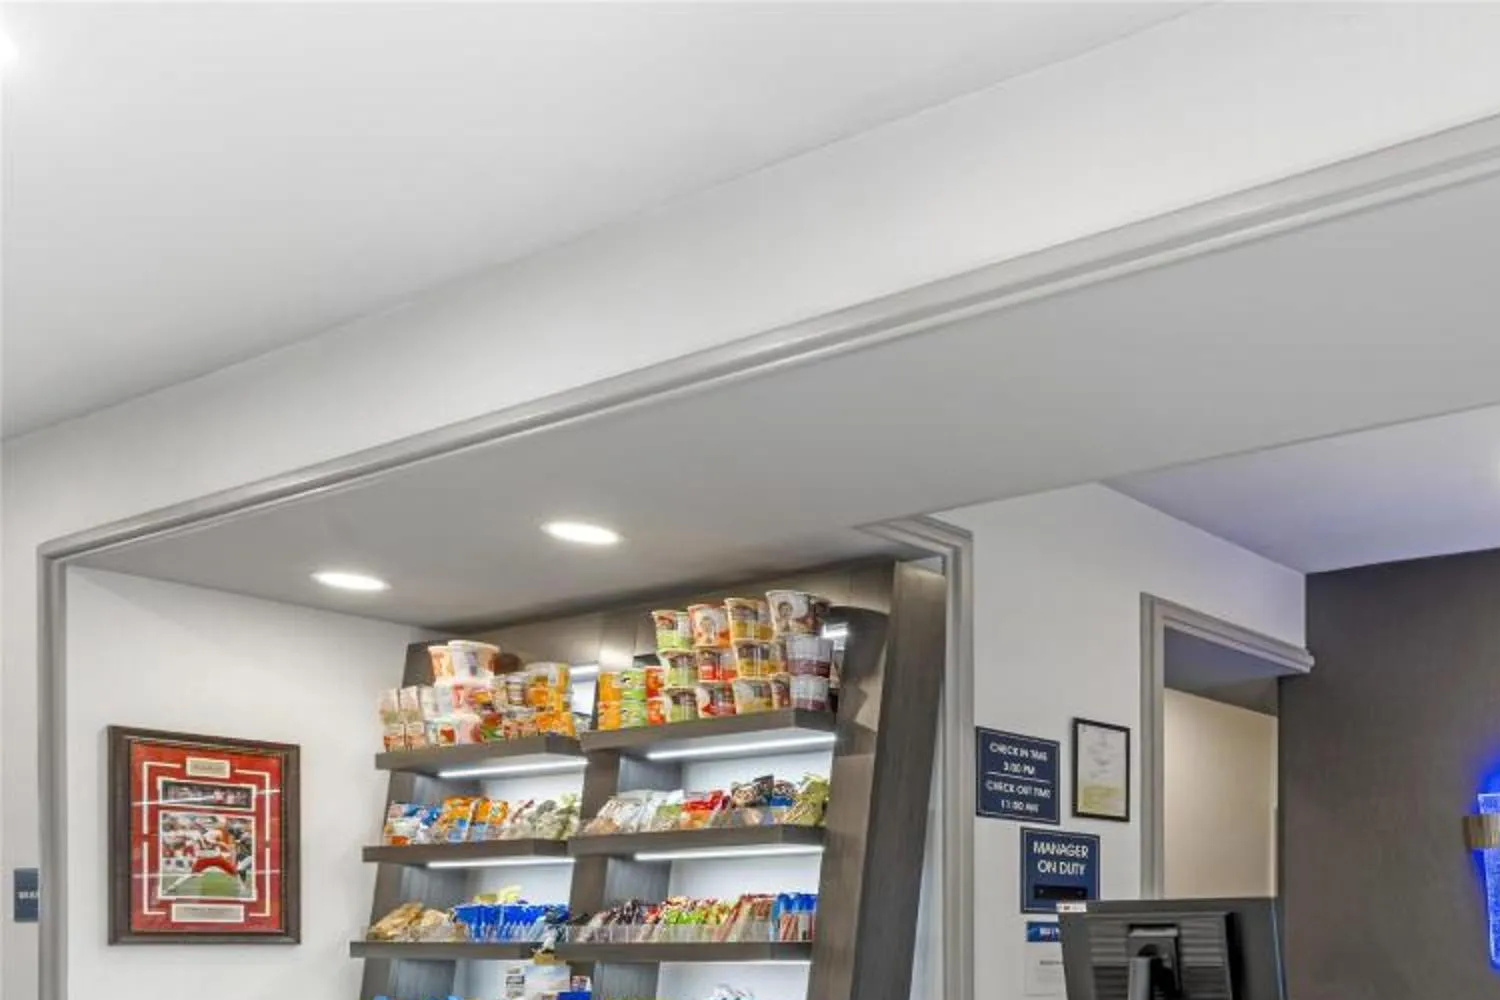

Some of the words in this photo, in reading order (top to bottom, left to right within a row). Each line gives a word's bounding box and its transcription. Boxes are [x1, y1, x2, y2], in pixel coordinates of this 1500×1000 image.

[1033, 841, 1089, 859] MANAGER
[1037, 860, 1057, 874] ON
[1058, 861, 1087, 876] DUTY
